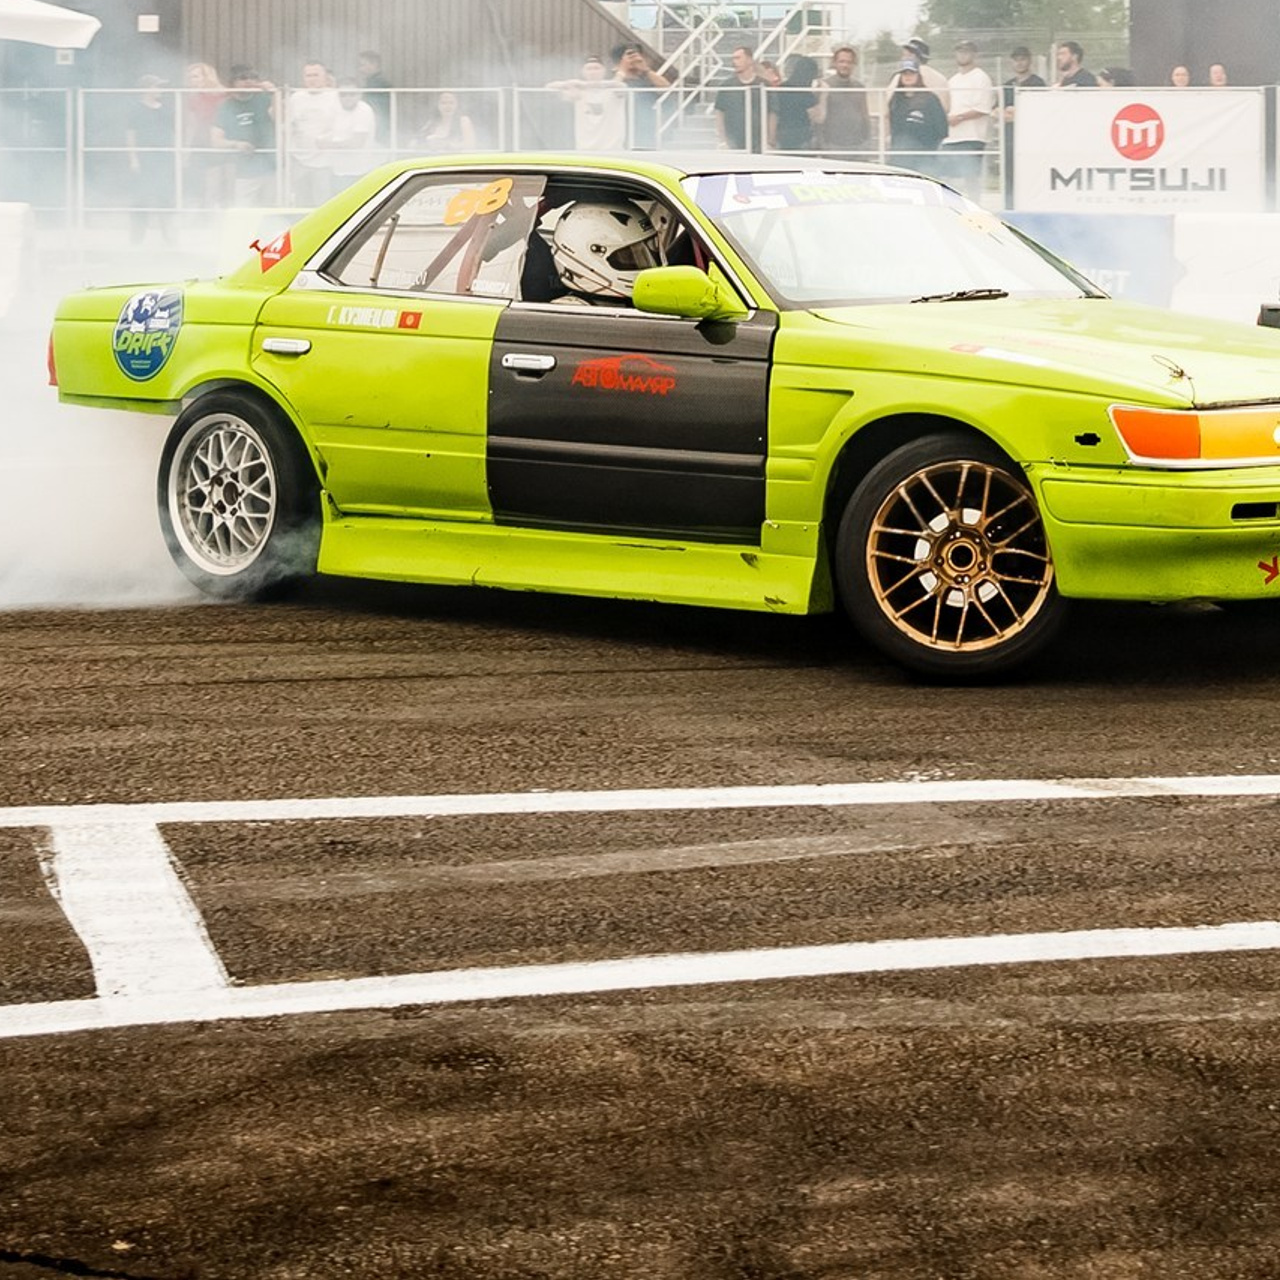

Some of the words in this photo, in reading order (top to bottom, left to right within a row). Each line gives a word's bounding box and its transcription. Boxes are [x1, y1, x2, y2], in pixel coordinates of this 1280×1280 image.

[1050, 167, 1227, 191] MITSUJI
[444, 177, 513, 226] 88
[116, 329, 173, 356] DRIFT
